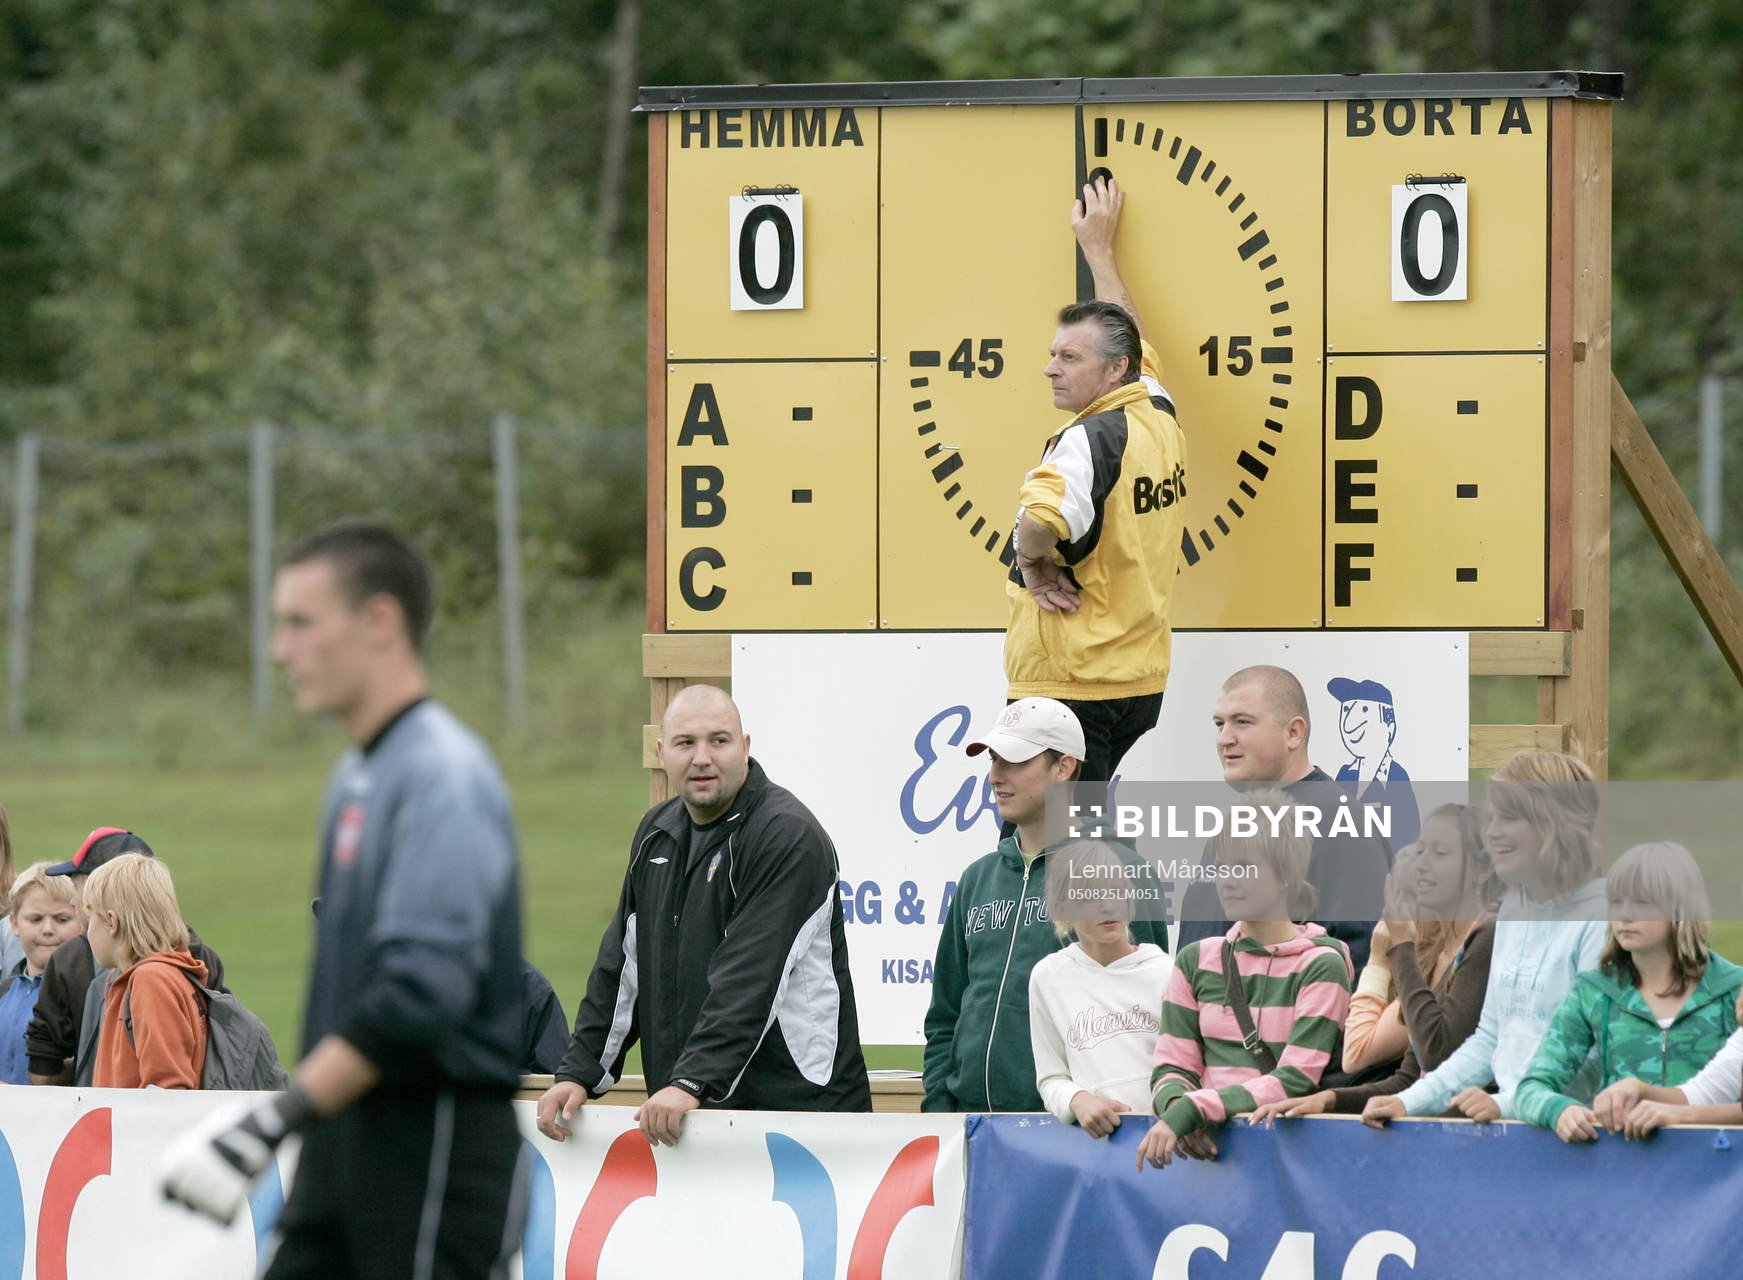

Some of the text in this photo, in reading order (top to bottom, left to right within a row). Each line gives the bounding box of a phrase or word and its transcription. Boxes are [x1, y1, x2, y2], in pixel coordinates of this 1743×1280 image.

[680, 107, 864, 149] HEMMA
[1345, 98, 1533, 137] BORTA
[738, 204, 796, 306] 0
[1399, 193, 1460, 297] 0
[947, 337, 1005, 379] 45
[1198, 335, 1254, 377] 15
[676, 382, 729, 447] A
[1334, 376, 1384, 441] D
[680, 465, 727, 529] B
[1334, 459, 1379, 524] E
[678, 546, 728, 612] C
[1334, 543, 1375, 608] F
[894, 880, 926, 925] &
[965, 899, 1016, 937] NEW
[881, 959, 934, 984] KISA
